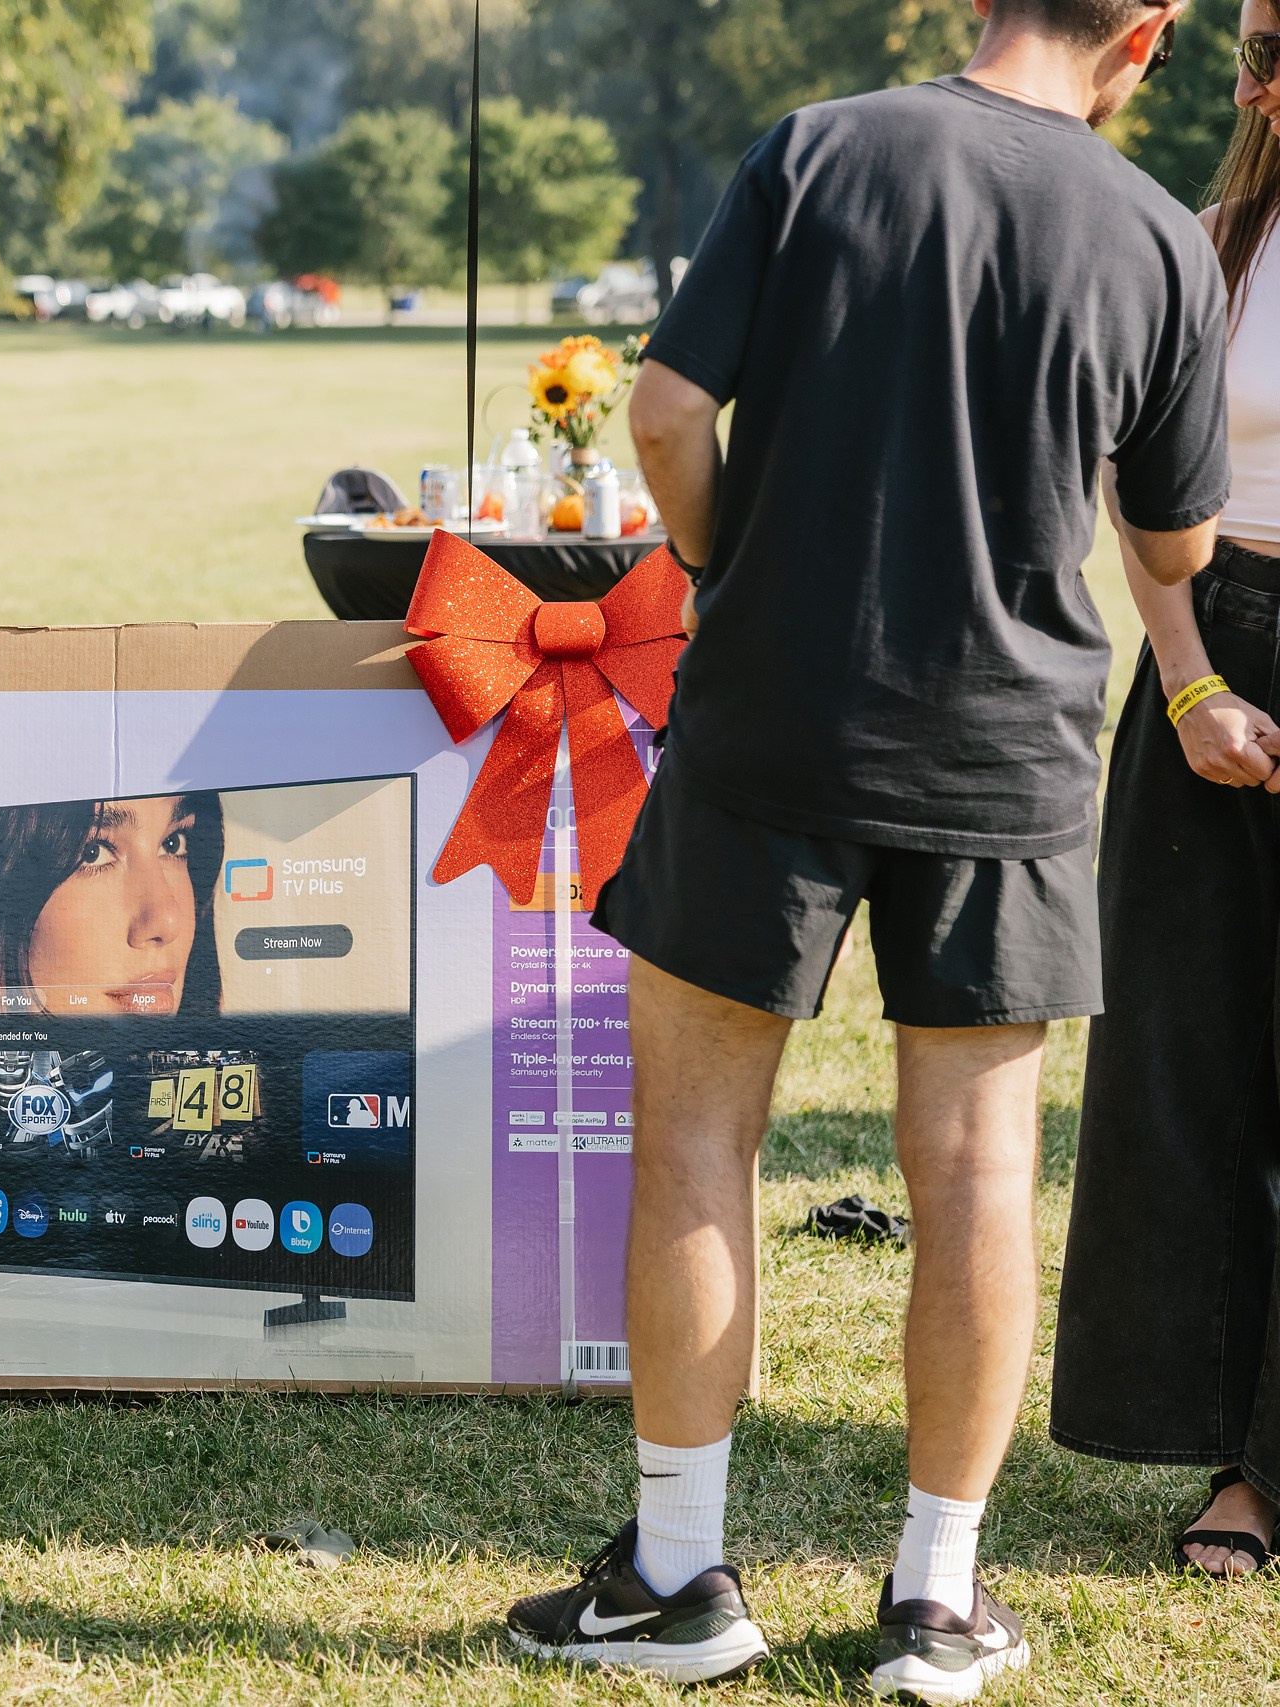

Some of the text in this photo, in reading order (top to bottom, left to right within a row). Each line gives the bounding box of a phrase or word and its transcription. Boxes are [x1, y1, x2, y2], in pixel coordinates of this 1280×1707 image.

[1194, 684, 1209, 696] Sep
[282, 856, 367, 877] Samsung
[283, 878, 344, 896] TV Plus
[263, 936, 322, 949] Stream Now
[510, 961, 540, 970] Crystal
[1, 994, 156, 1009] For You Live Apps
[510, 997, 526, 1005] HDR
[510, 1017, 630, 1030] Stream 2700+ free
[22, 1032, 33, 1041] for
[34, 1032, 48, 1041] You
[510, 1032, 541, 1040] Endless
[510, 1052, 587, 1067] Triple-layer
[591, 1053, 624, 1065] data
[510, 1068, 548, 1077] Samsung
[570, 1069, 604, 1078] Security
[21, 1095, 57, 1116] FOX
[150, 1098, 172, 1106] FIRST
[21, 1116, 57, 1124] SPORTS
[184, 1133, 208, 1146] BY
[526, 1138, 557, 1147] matter
[571, 1136, 630, 1150] 4K ULTRA HD
[59, 1208, 87, 1222] hulu
[113, 1210, 126, 1224] tv
[143, 1214, 175, 1226] peacock
[191, 1213, 220, 1232] sling
[246, 1219, 270, 1230] YouTube
[344, 1226, 371, 1235] Internet
[290, 1237, 312, 1250] Bixby
